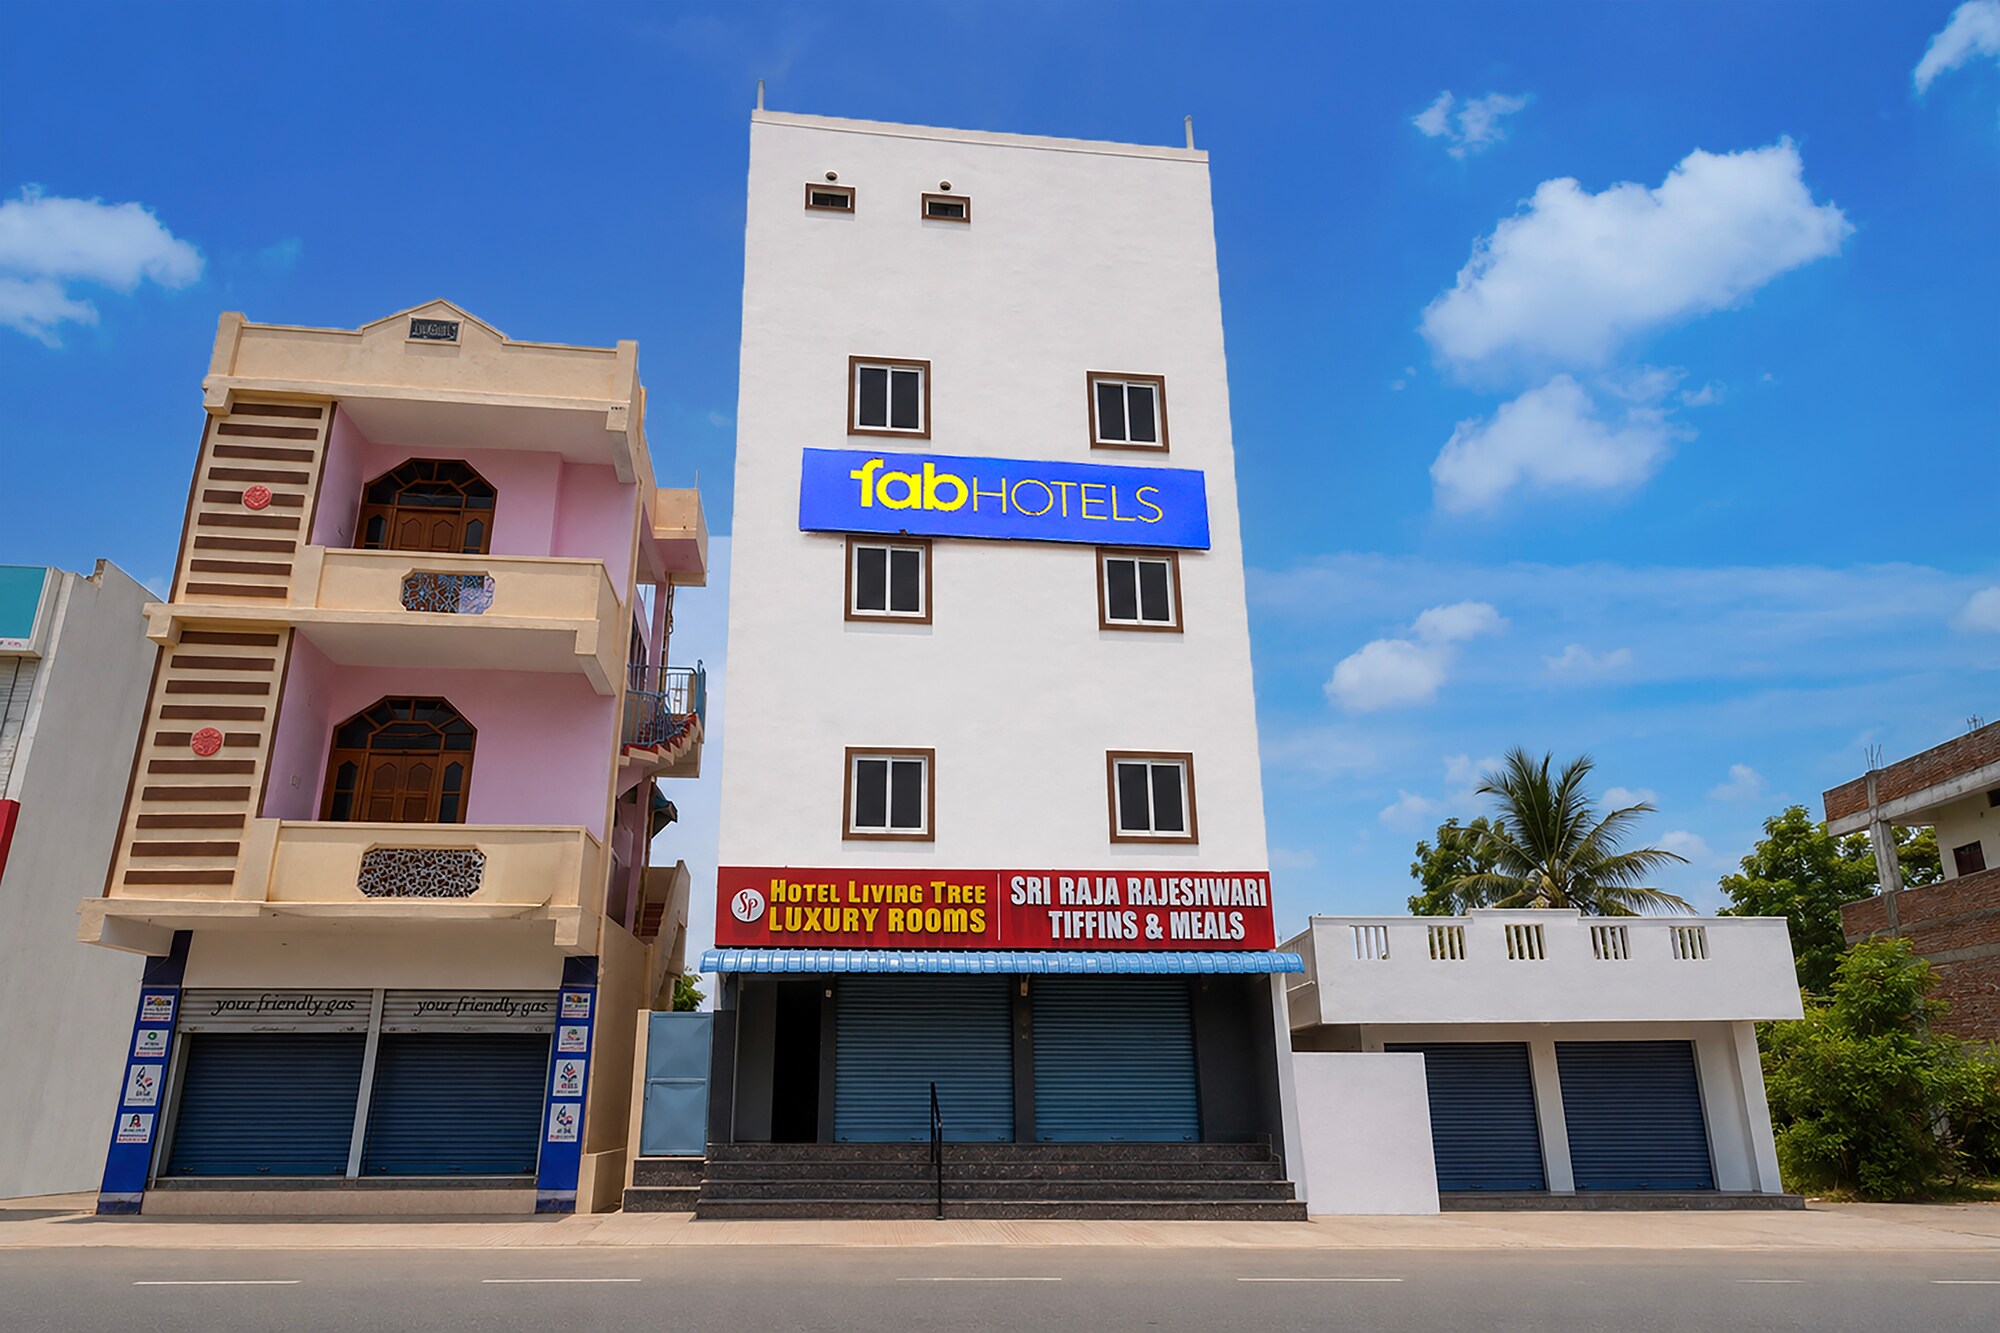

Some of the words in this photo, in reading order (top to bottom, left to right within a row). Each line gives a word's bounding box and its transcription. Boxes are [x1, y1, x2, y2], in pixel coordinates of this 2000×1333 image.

[1011, 876, 1050, 905] SRI
[1059, 877, 1121, 906] RAJA
[1127, 877, 1267, 907] RAJESHWARI
[769, 906, 879, 932] LUXURY
[888, 907, 986, 933] ROOMS
[1048, 910, 1138, 939] TIFFINS
[1145, 913, 1163, 940] &
[1170, 911, 1246, 940] MEALS
[211, 999, 254, 1016] your
[256, 993, 322, 1016] friendly
[323, 999, 356, 1016] gas
[413, 1000, 452, 1016] your
[452, 996, 521, 1017] friendly
[520, 1001, 548, 1017] gas
